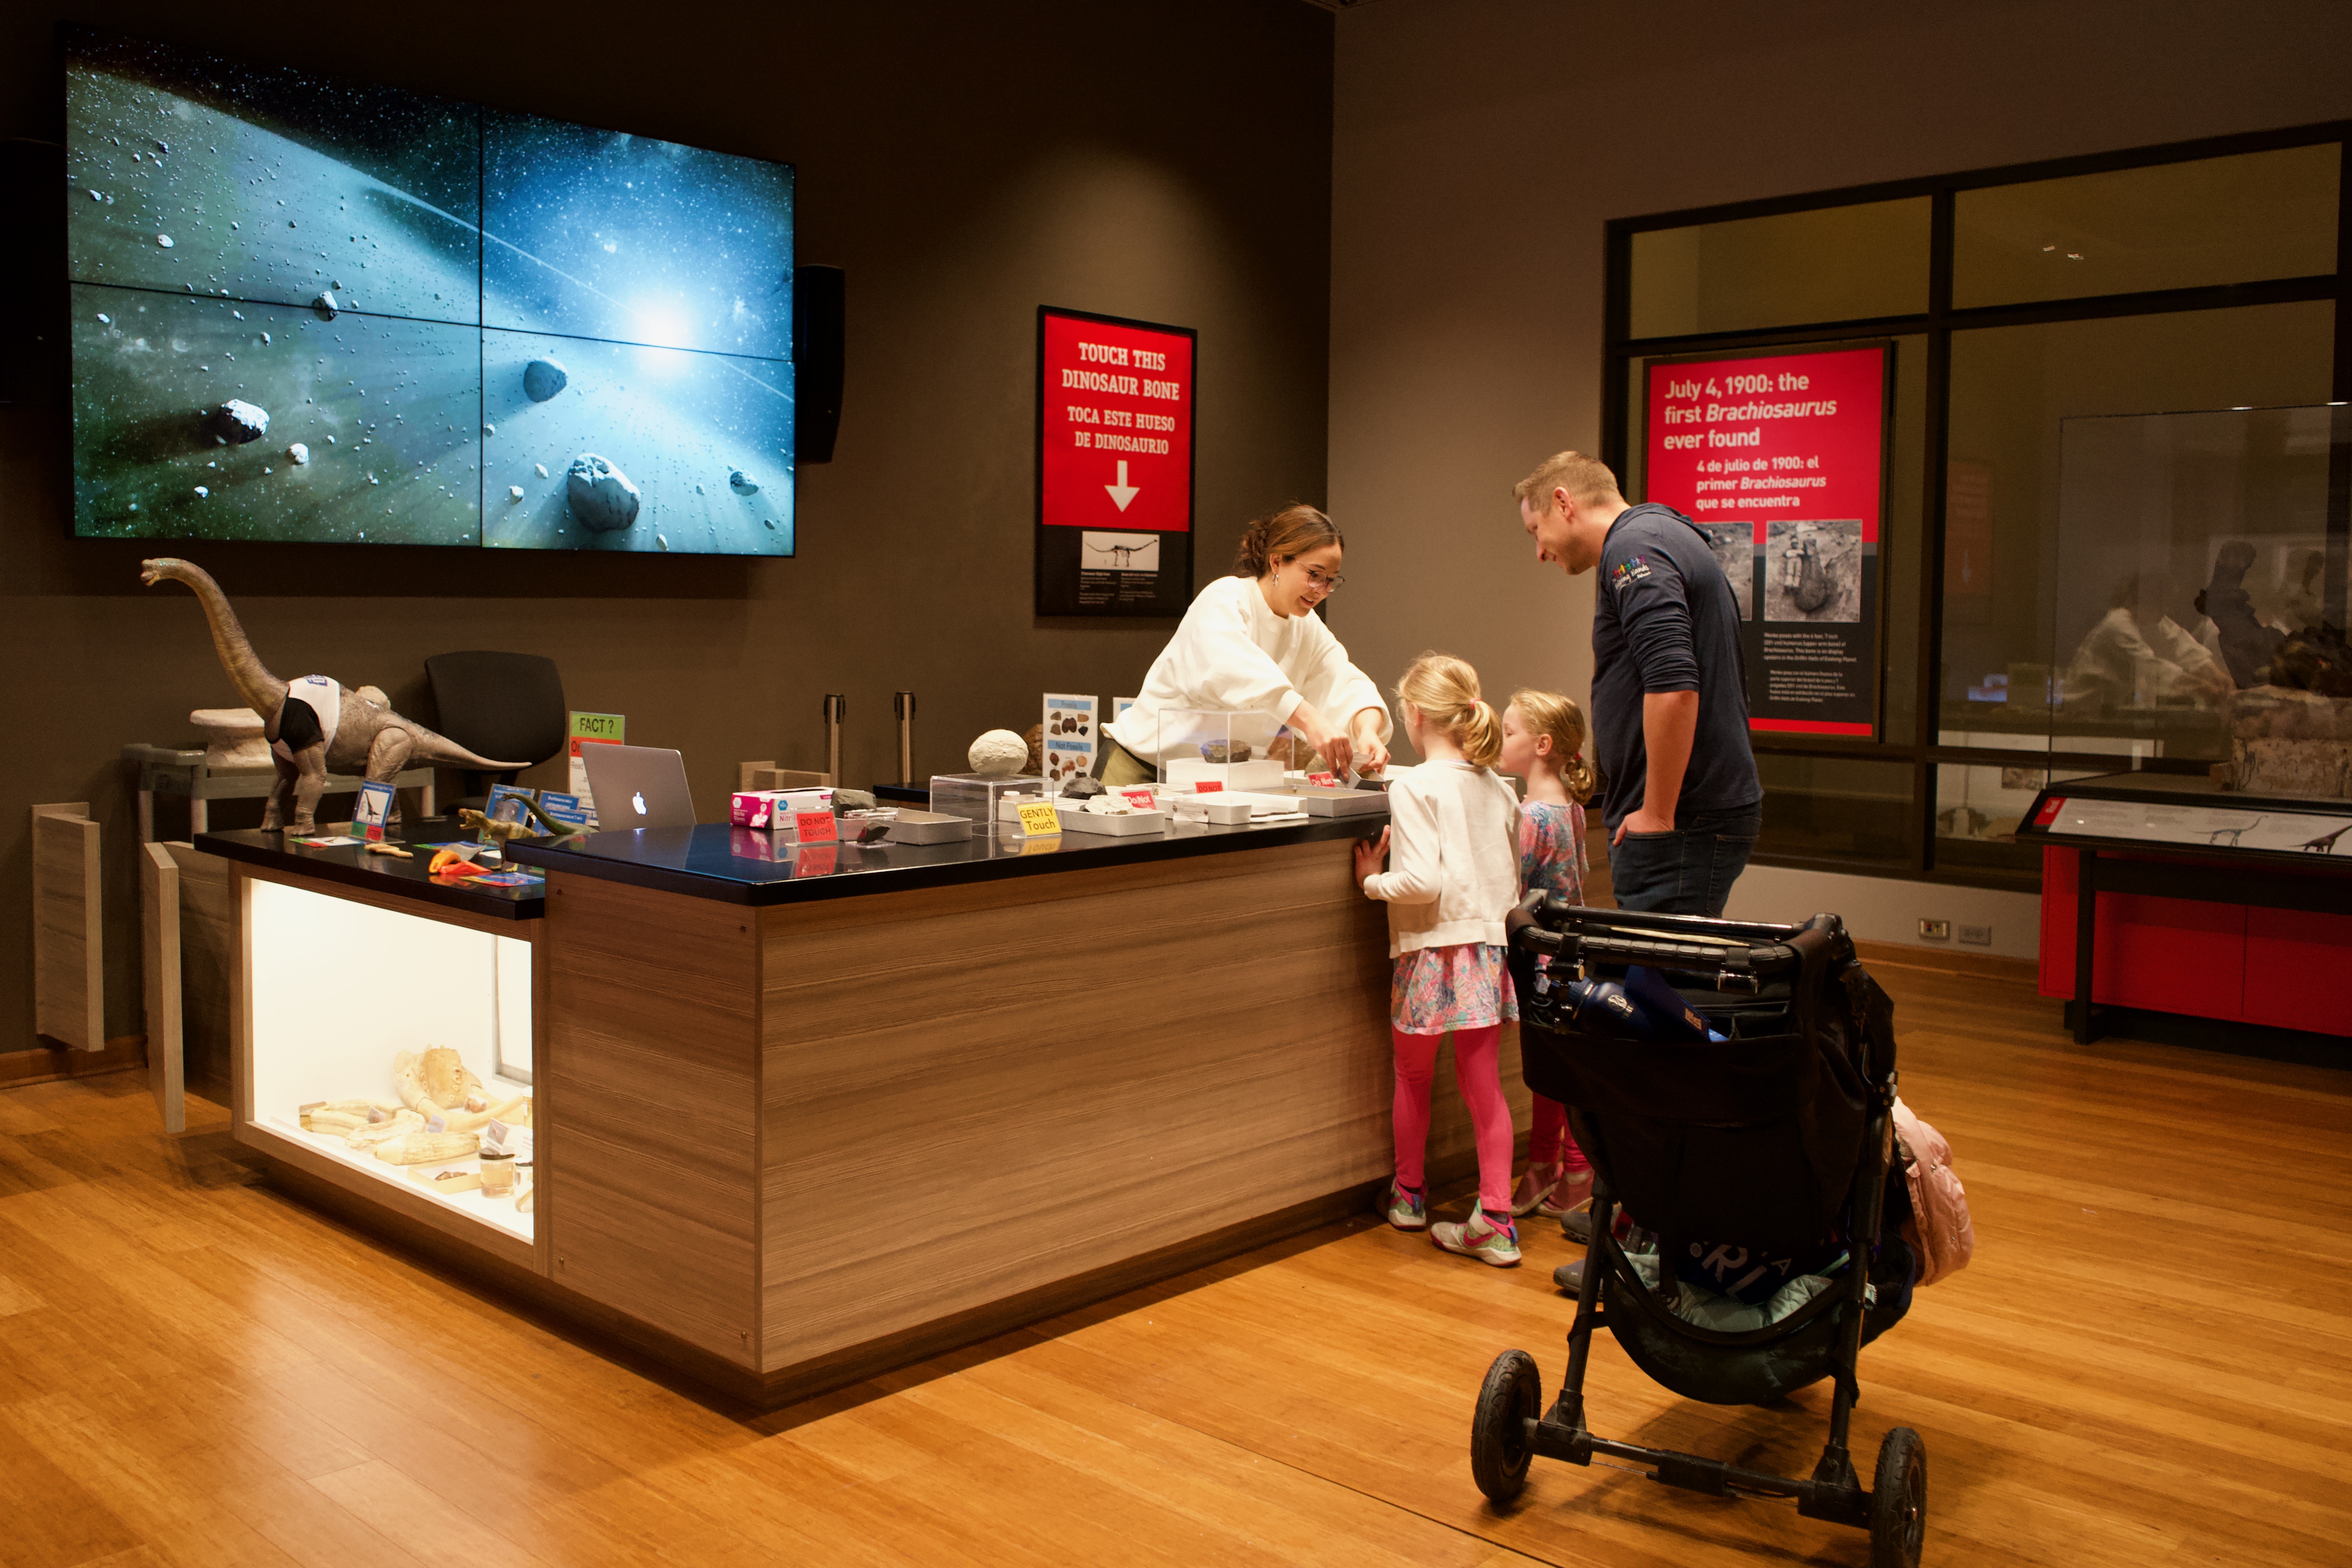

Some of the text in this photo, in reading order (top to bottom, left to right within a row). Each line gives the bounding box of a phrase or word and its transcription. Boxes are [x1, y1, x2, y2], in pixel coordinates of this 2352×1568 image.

[1079, 342, 1165, 371] TOUCH THIS
[1062, 369, 1180, 401] DINOSAUR BONE
[1666, 373, 1809, 401] July 4, 1900: the
[1068, 406, 1175, 432] TOCA ESTE HUESO
[1665, 400, 1836, 424] first Brachiosaurus
[1075, 431, 1169, 455] DE DINOSAURIO
[1664, 427, 1760, 449] ever found
[1697, 455, 1819, 475] 4 de julio de 1900: el
[1696, 476, 1827, 493] primer Brachiosaurus
[1696, 494, 1800, 511] que se encuentra
[580, 717, 614, 734] FACT ?
[1138, 795, 1151, 803] Not
[1020, 808, 1053, 818] GENTLY
[803, 827, 831, 836] TOUCH
[1026, 819, 1056, 830] Touch
